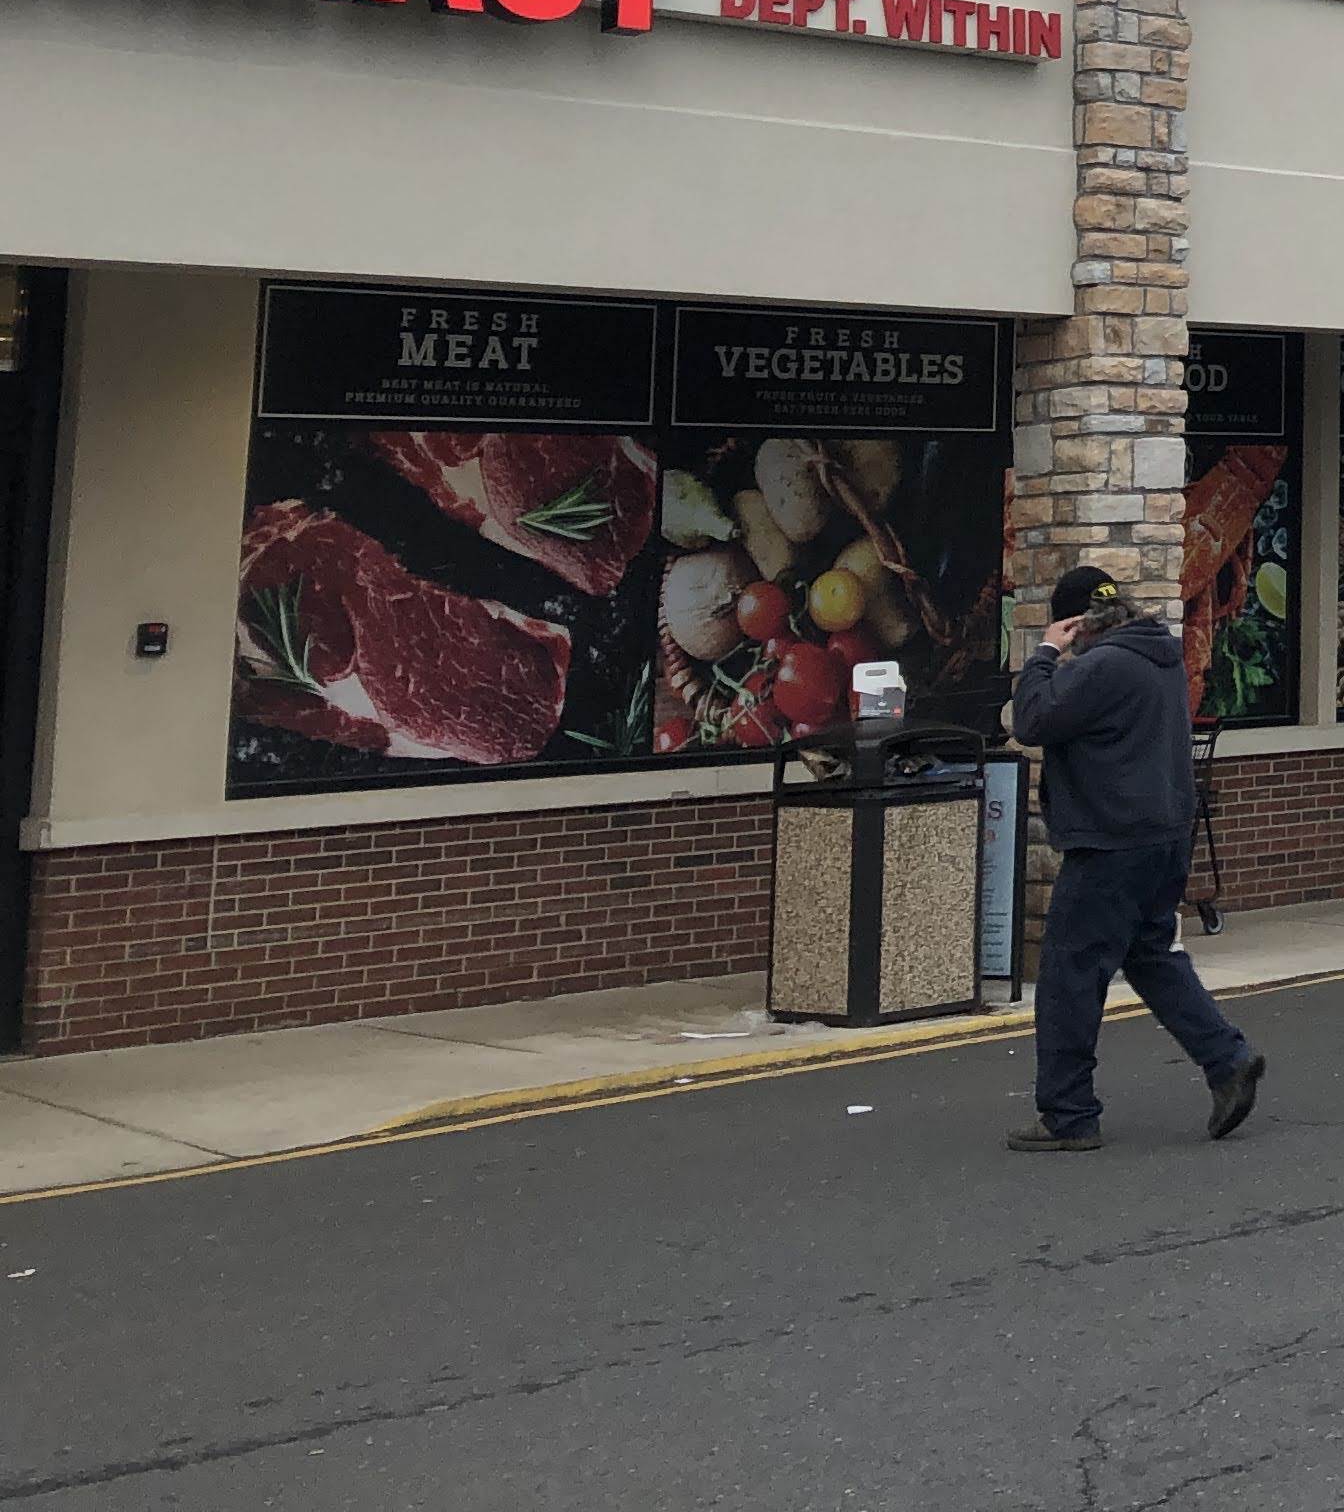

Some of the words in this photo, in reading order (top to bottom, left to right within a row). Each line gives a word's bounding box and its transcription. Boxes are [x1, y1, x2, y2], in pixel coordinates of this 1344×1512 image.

[400, 308, 540, 333] FRESH
[785, 327, 900, 348] FRESH
[398, 332, 539, 370] MEAT
[714, 345, 964, 385] VEGETABLES
[423, 380, 458, 391] MEAT
[345, 392, 414, 403] PREMIUM
[421, 395, 482, 405] QUALITY
